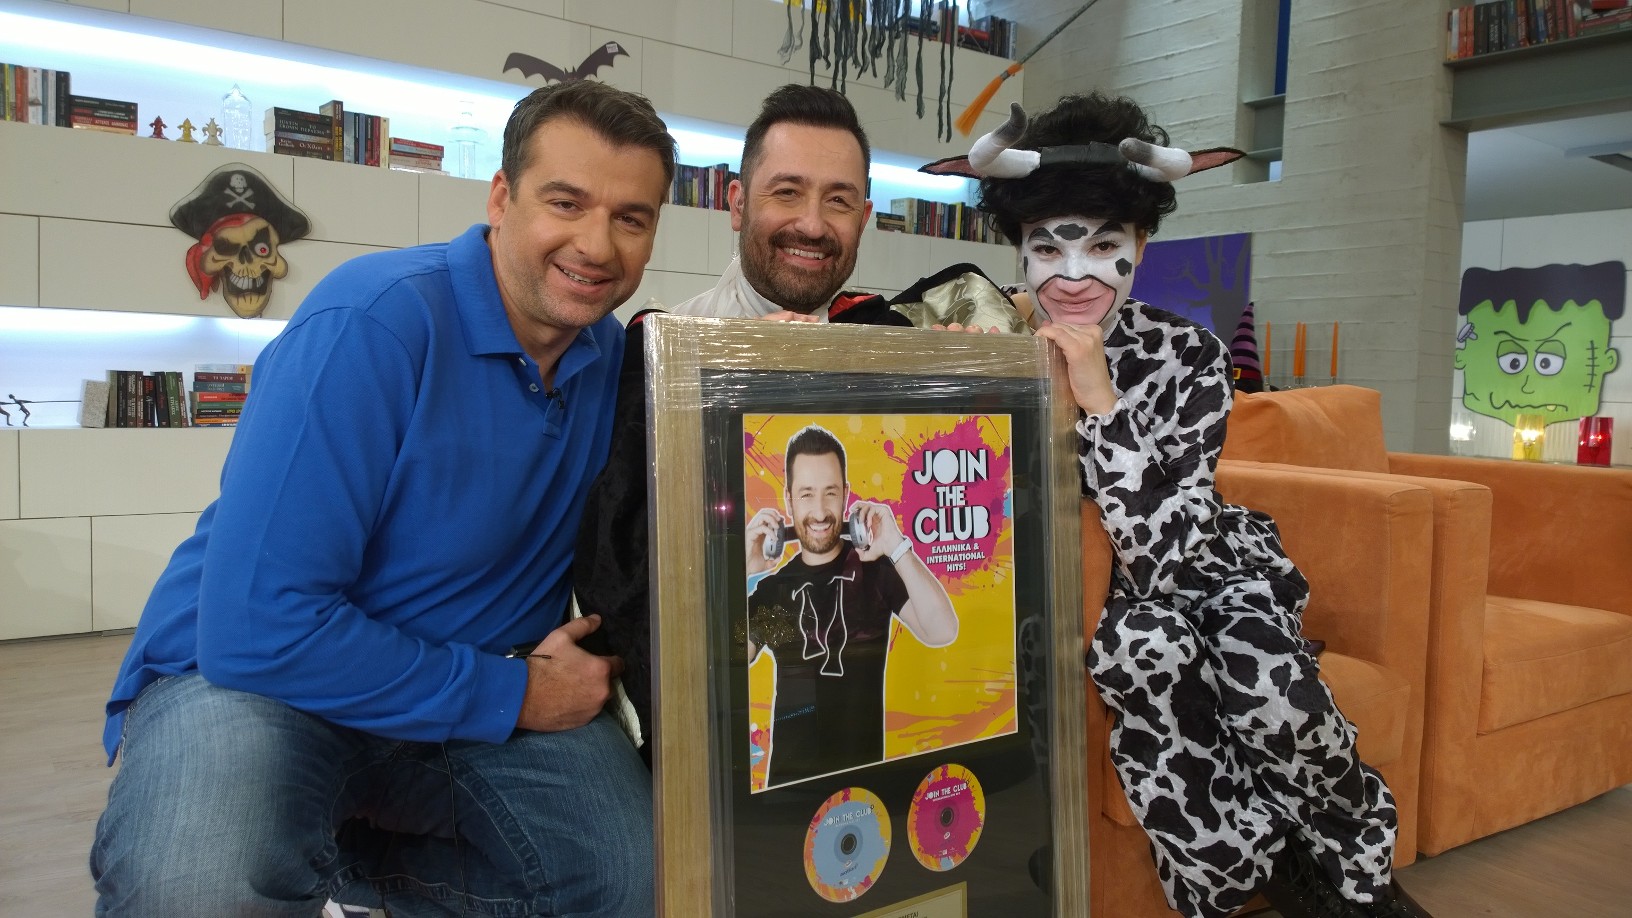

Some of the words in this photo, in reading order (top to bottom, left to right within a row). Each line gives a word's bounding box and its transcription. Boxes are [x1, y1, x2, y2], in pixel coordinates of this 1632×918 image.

[913, 448, 989, 485] JOIN
[934, 485, 968, 506] THE
[913, 506, 991, 544] CLUB
[931, 544, 971, 554] ΕΛΛΗΝΙΚΑ
[973, 543, 980, 552] &
[926, 552, 986, 565] INTERNATIONAL
[946, 562, 967, 572] HITS!
[925, 789, 940, 801] JOIN
[941, 786, 951, 797] THE
[953, 782, 968, 793] CLUB
[824, 815, 840, 826] JOIN
[842, 811, 855, 822] THE
[855, 807, 872, 818] CLUB
